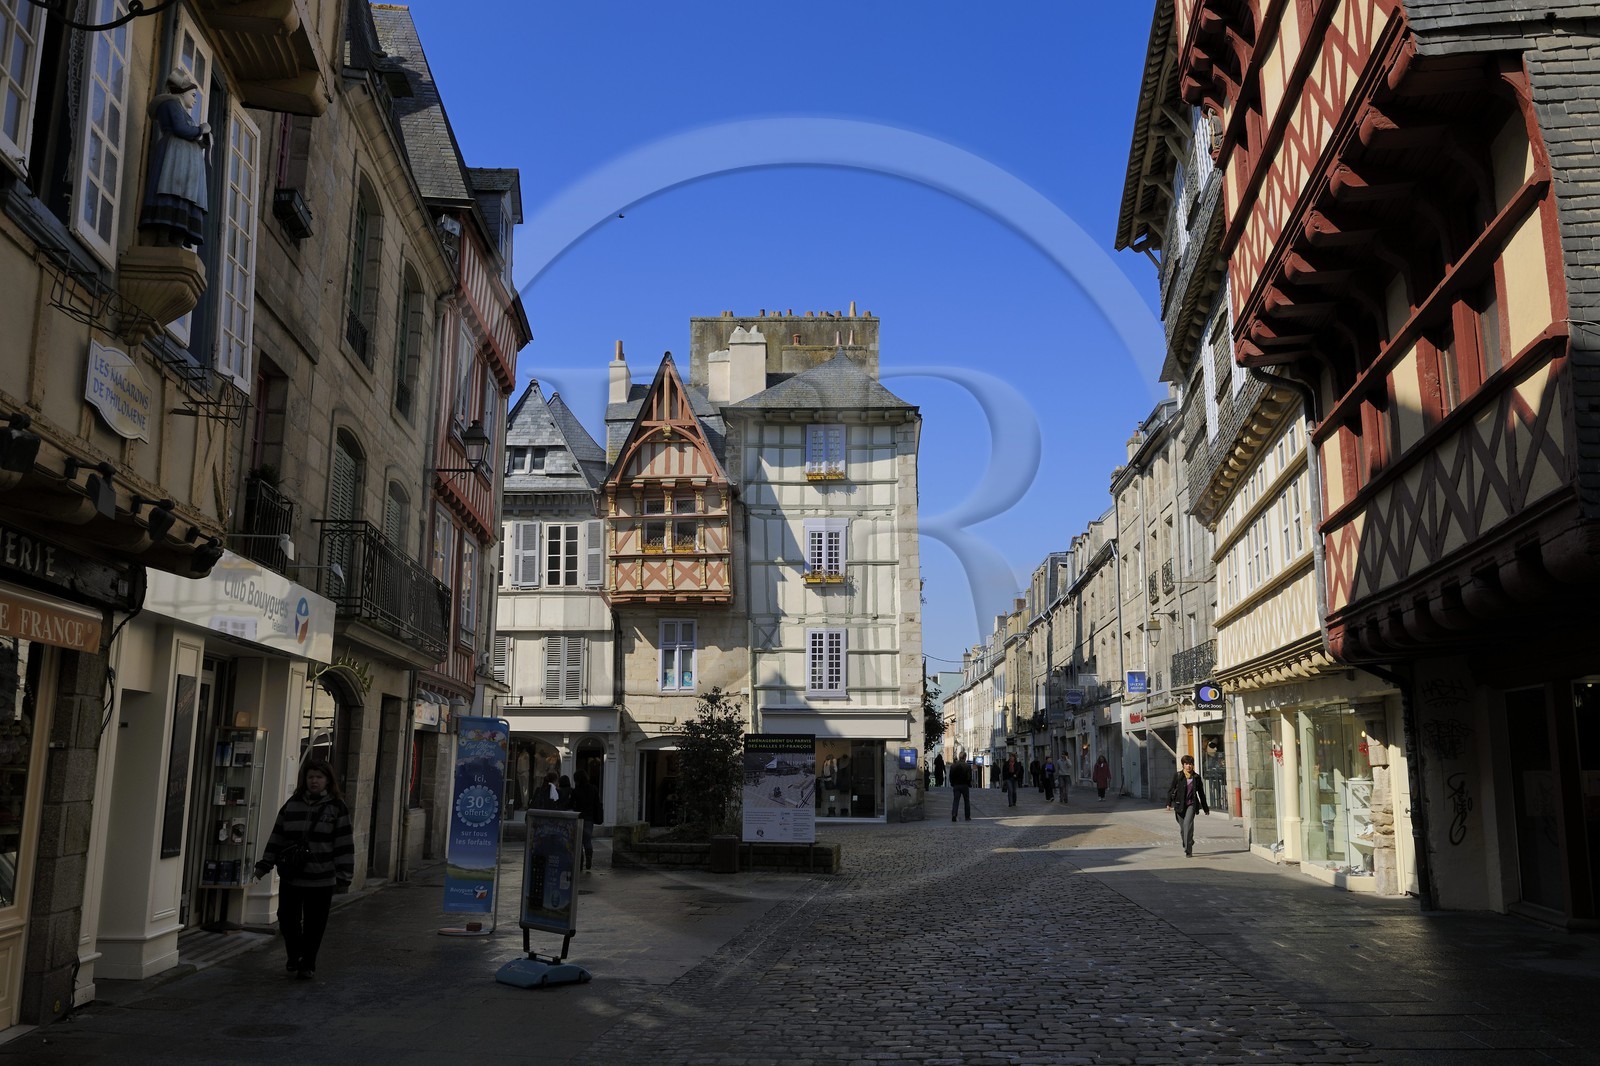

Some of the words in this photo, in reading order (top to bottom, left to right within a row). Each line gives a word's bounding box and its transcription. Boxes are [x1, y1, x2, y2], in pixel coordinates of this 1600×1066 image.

[94, 354, 110, 378] LES
[110, 367, 149, 410] MACARONS
[93, 377, 105, 398] DE
[105, 387, 147, 431] PHILOMENE
[0, 526, 57, 577] ERIE
[224, 574, 247, 602] Club
[247, 581, 289, 620] Bouygues
[20, 607, 85, 647] FRANCE
[474, 774, 487, 783] Ici,
[464, 808, 489, 817] offerts
[467, 838, 492, 846] forfaits
